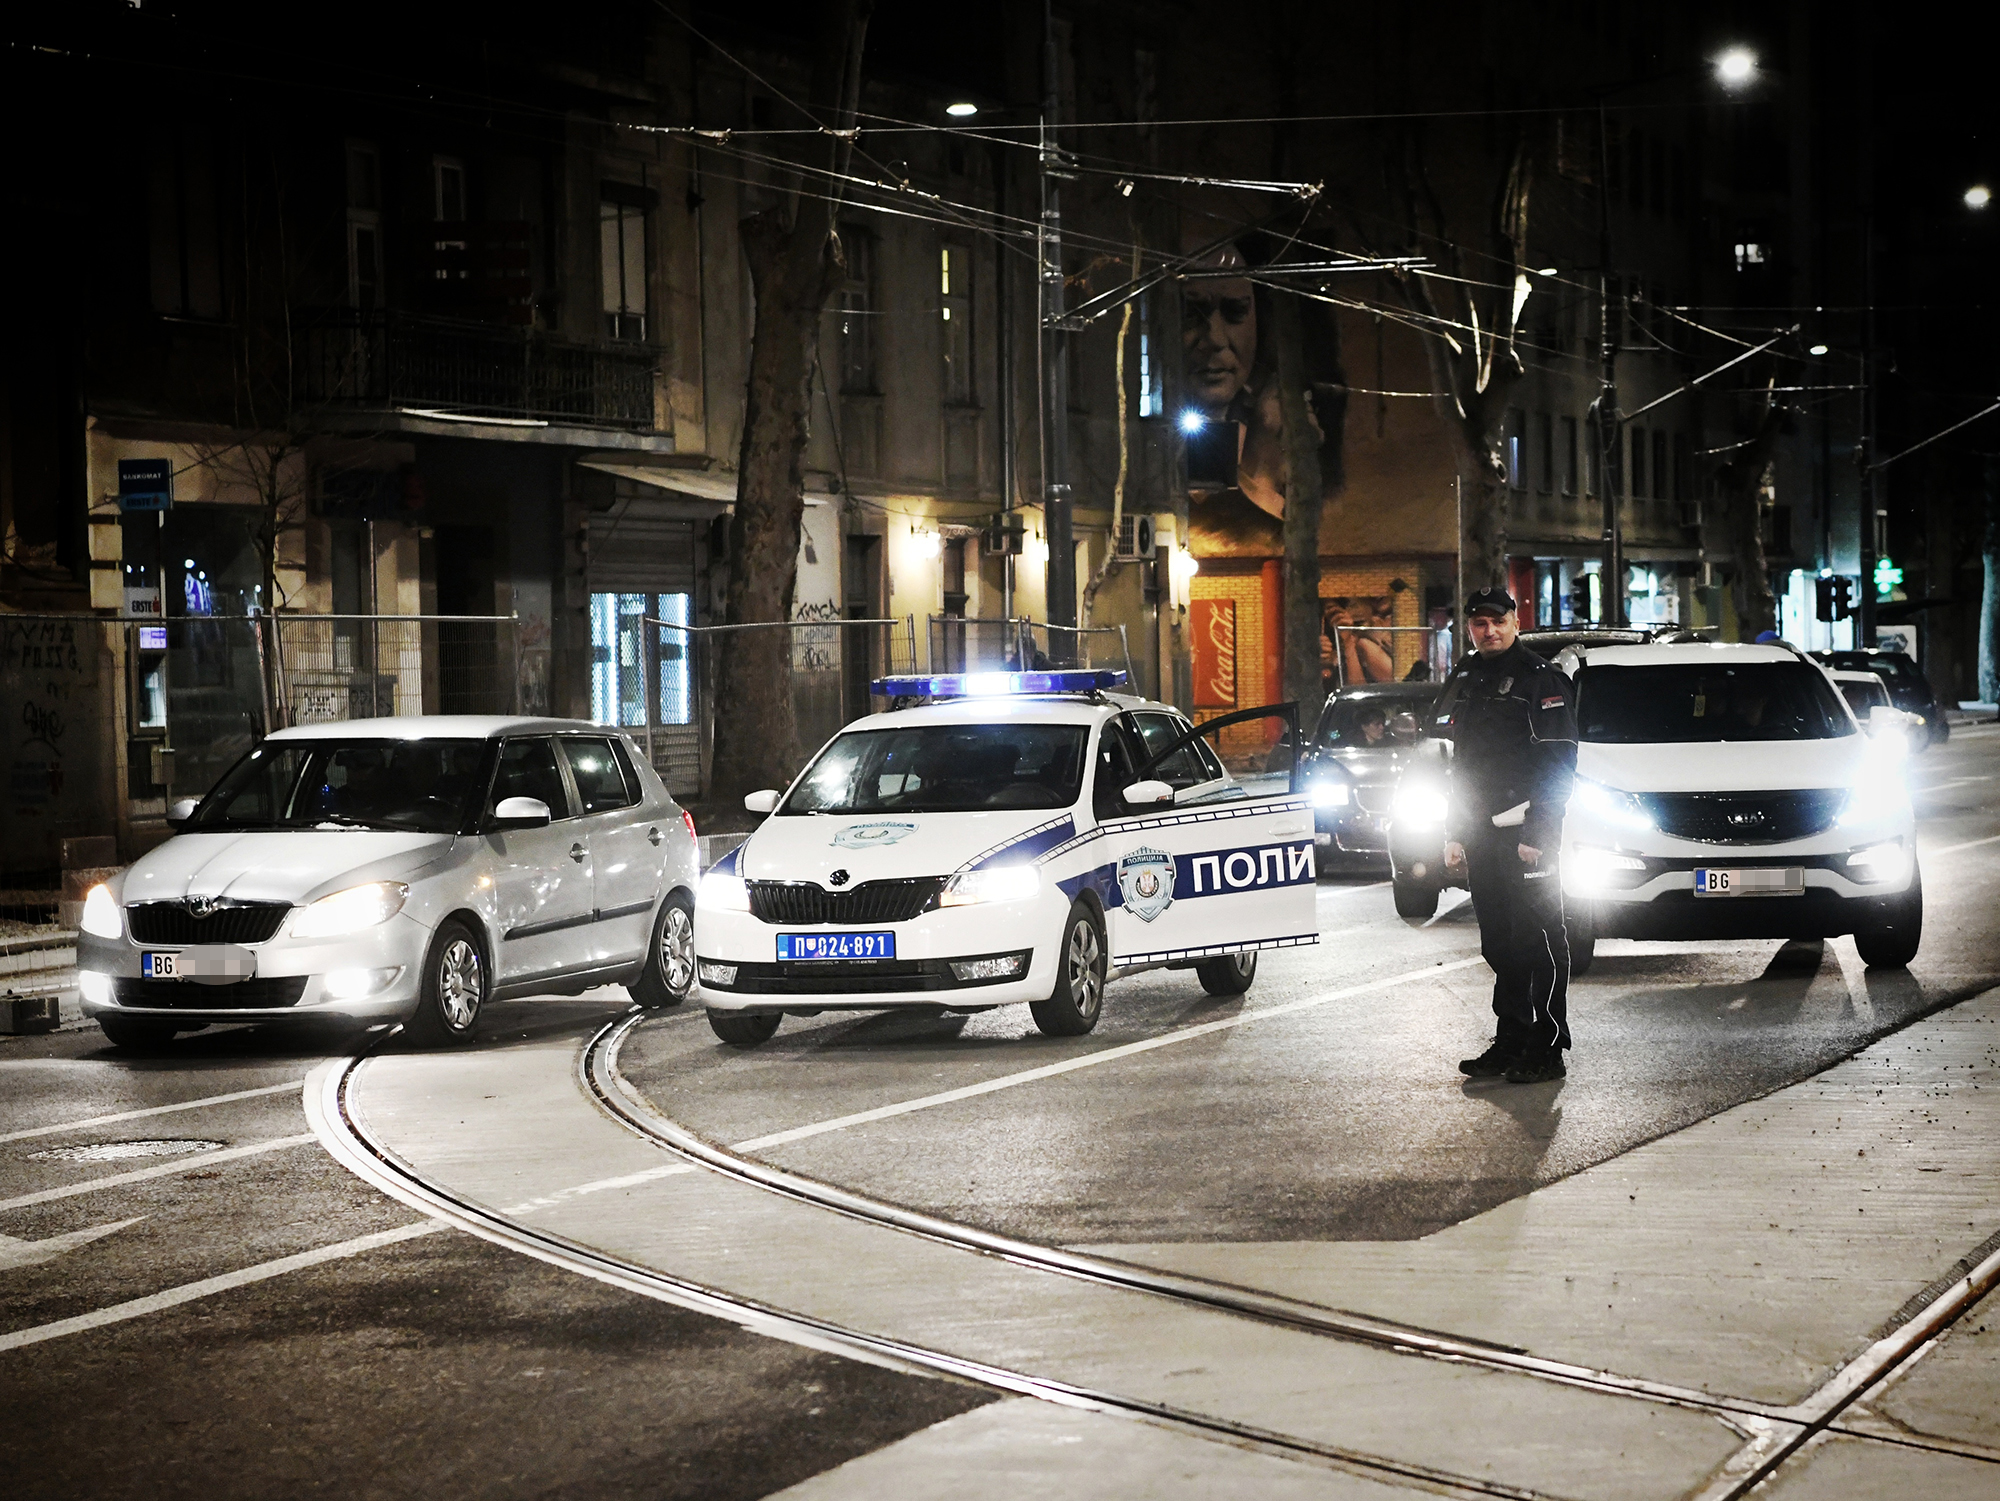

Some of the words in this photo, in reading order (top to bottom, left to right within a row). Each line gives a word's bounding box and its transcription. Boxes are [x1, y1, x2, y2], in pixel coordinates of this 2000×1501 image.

[122, 472, 161, 480] BANKOMAT
[132, 600, 152, 613] ERSTE
[1209, 601, 1234, 703] Coca-Cola
[1734, 812, 1759, 824] KIA
[1126, 854, 1164, 865] ПОЛИЦИЈА
[1192, 843, 1316, 893] ПОЛИ
[1709, 872, 1729, 890] BG
[154, 956, 173, 975] BG
